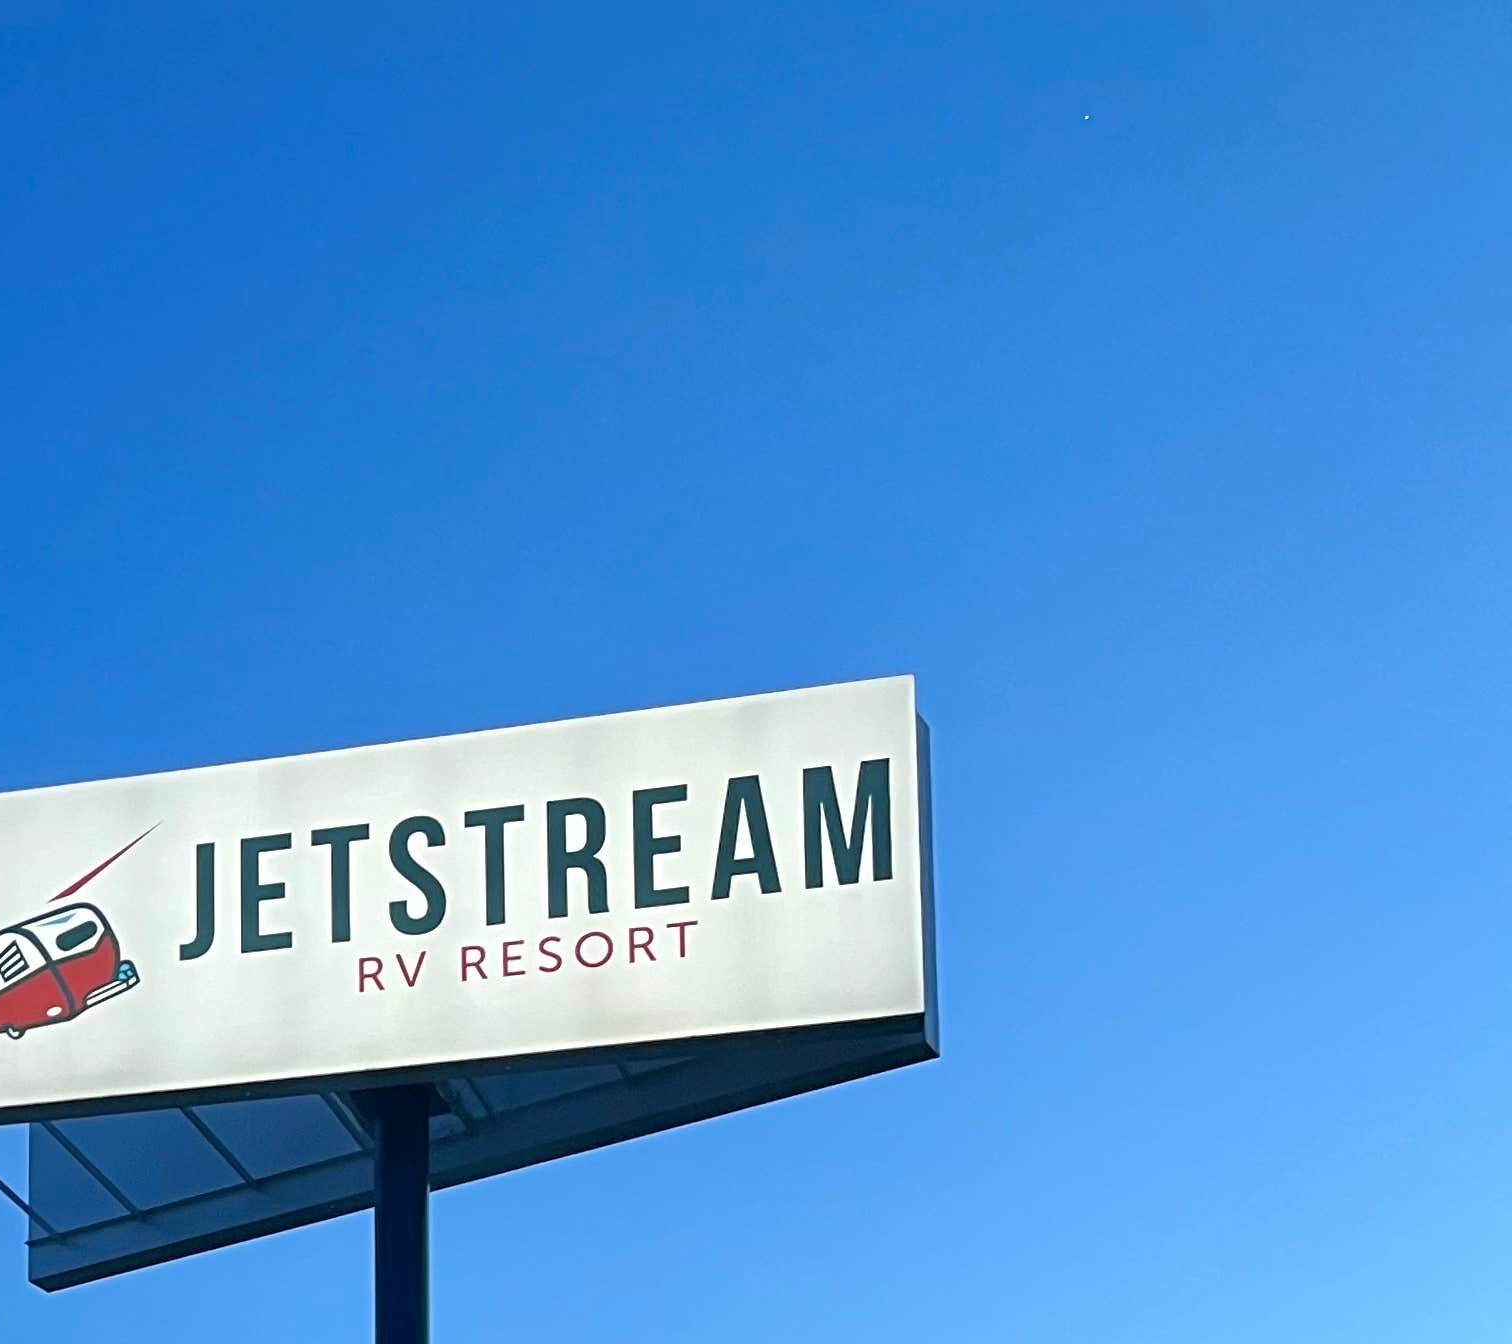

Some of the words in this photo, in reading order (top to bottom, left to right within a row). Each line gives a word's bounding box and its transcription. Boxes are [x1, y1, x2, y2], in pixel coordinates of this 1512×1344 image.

[179, 757, 894, 961] JETSTREAM
[357, 950, 427, 993] RV
[460, 920, 699, 982] RESORT
